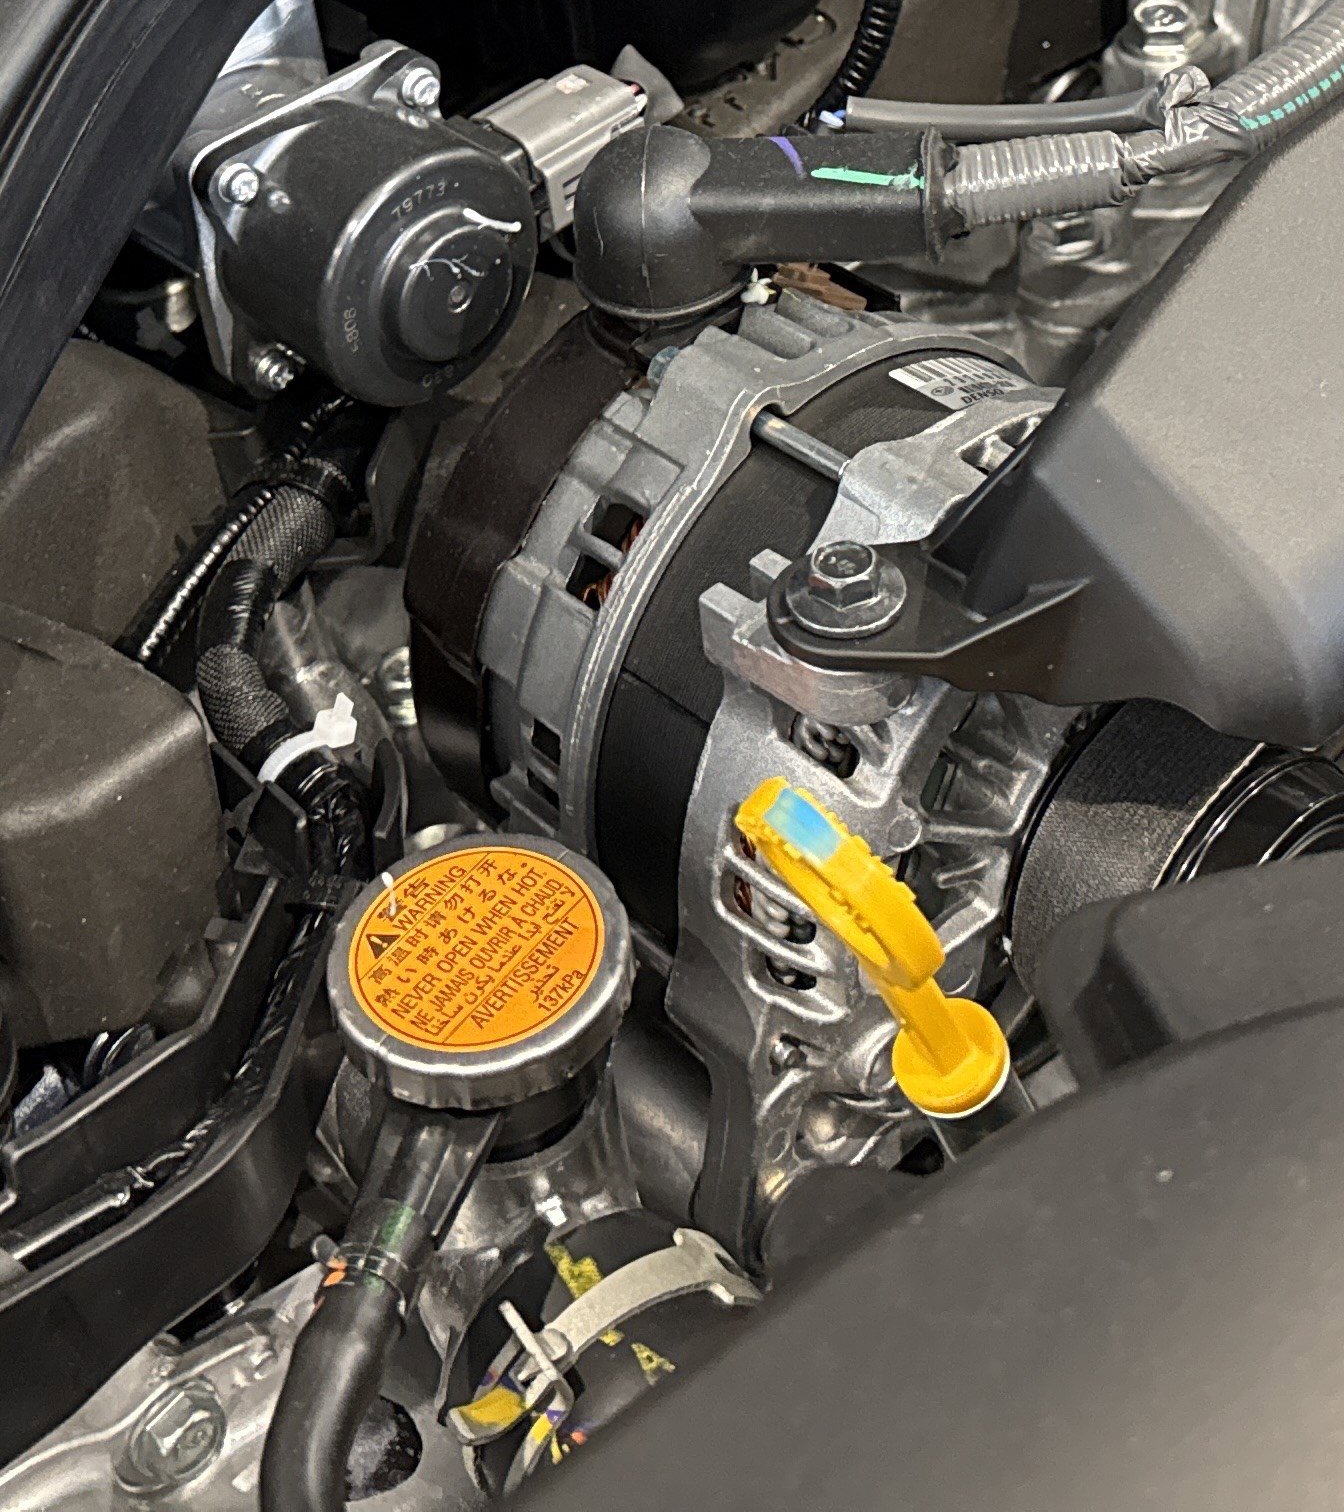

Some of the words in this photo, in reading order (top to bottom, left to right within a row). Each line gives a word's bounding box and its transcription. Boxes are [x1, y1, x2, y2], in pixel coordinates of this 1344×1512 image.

[959, 387, 1006, 405] DENSO
[392, 865, 468, 931] WARNING
[391, 972, 443, 1020] NEVER
[436, 935, 479, 974] OPEN
[470, 894, 518, 936] WHEN
[409, 1008, 436, 1032] NE
[429, 967, 476, 1013] JAMAIS
[469, 926, 518, 970] OUVRIR
[470, 916, 580, 1030] AVERTISSEMENT
[537, 969, 586, 1012] 137kPa
